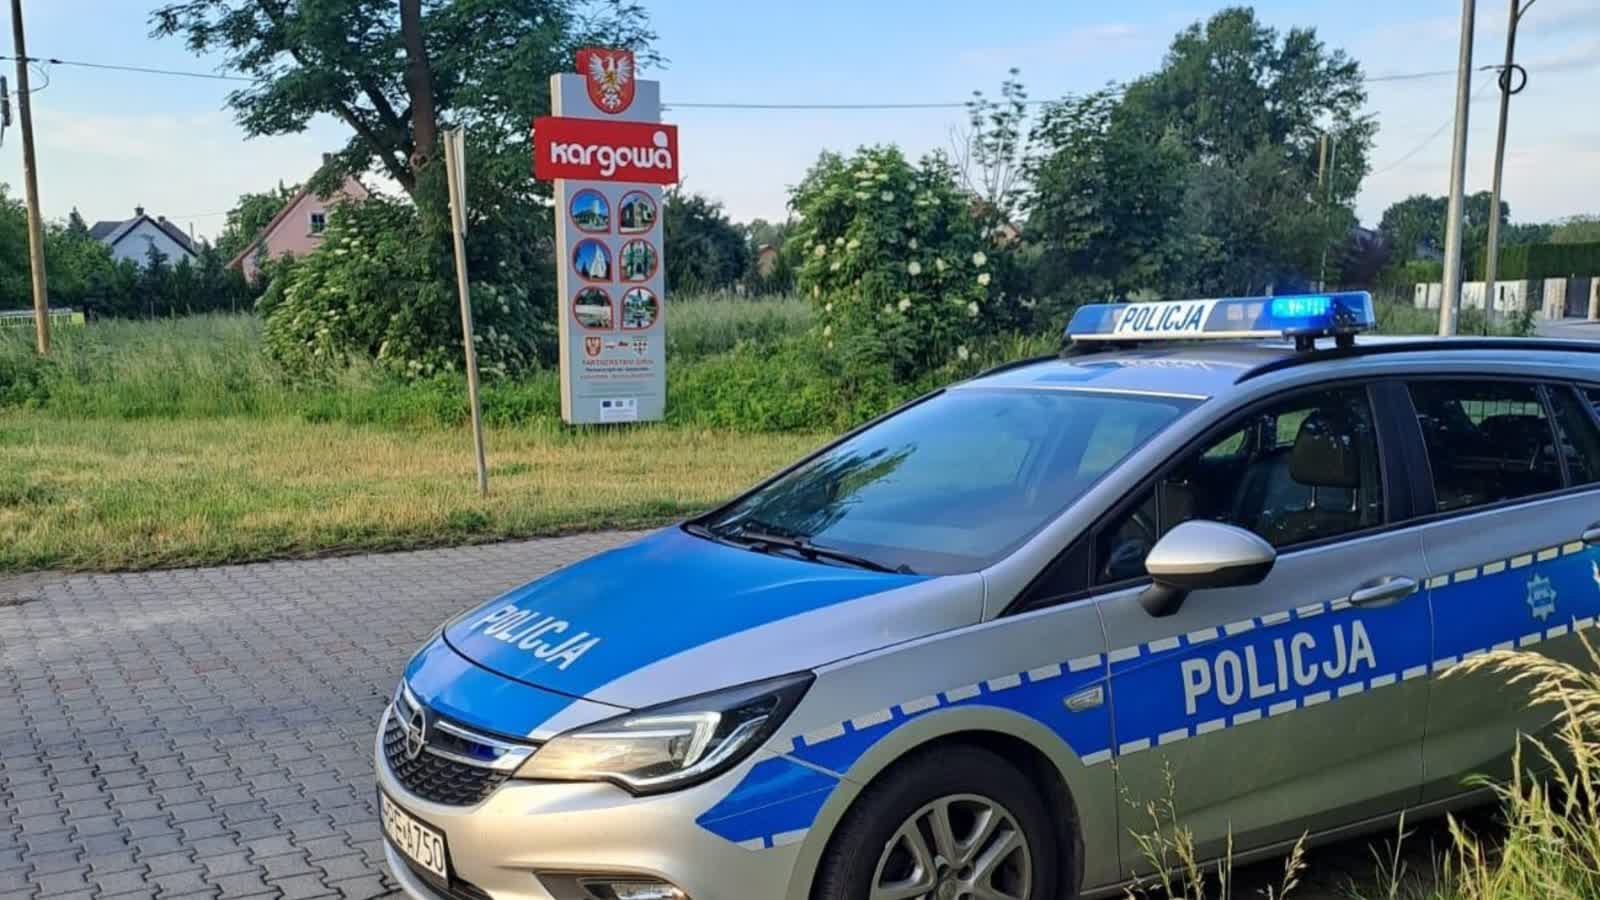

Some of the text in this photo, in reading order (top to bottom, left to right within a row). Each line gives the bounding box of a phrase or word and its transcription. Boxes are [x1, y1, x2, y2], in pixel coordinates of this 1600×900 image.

[1118, 304, 1206, 331] POLICJA
[468, 603, 601, 671] POLICJA
[1181, 619, 1377, 715] POLICJA
